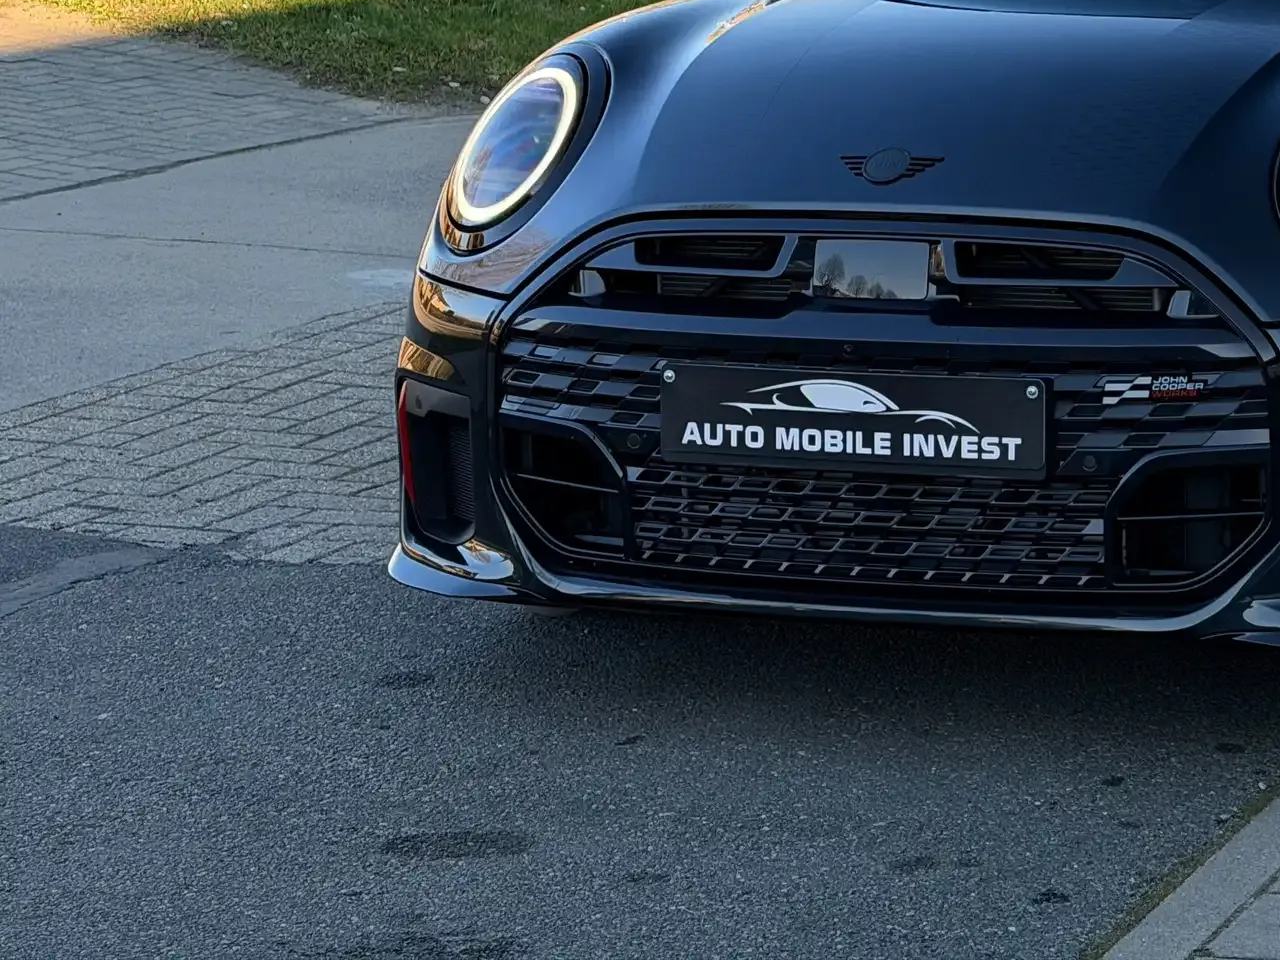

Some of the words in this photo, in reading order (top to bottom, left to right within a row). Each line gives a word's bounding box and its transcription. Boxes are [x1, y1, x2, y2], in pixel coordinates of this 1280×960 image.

[1153, 376, 1188, 384] JOHN
[1151, 382, 1204, 391] COOPER
[681, 421, 765, 449] AUTO
[775, 426, 893, 456] MOBILE
[902, 433, 1022, 461] INVEST
